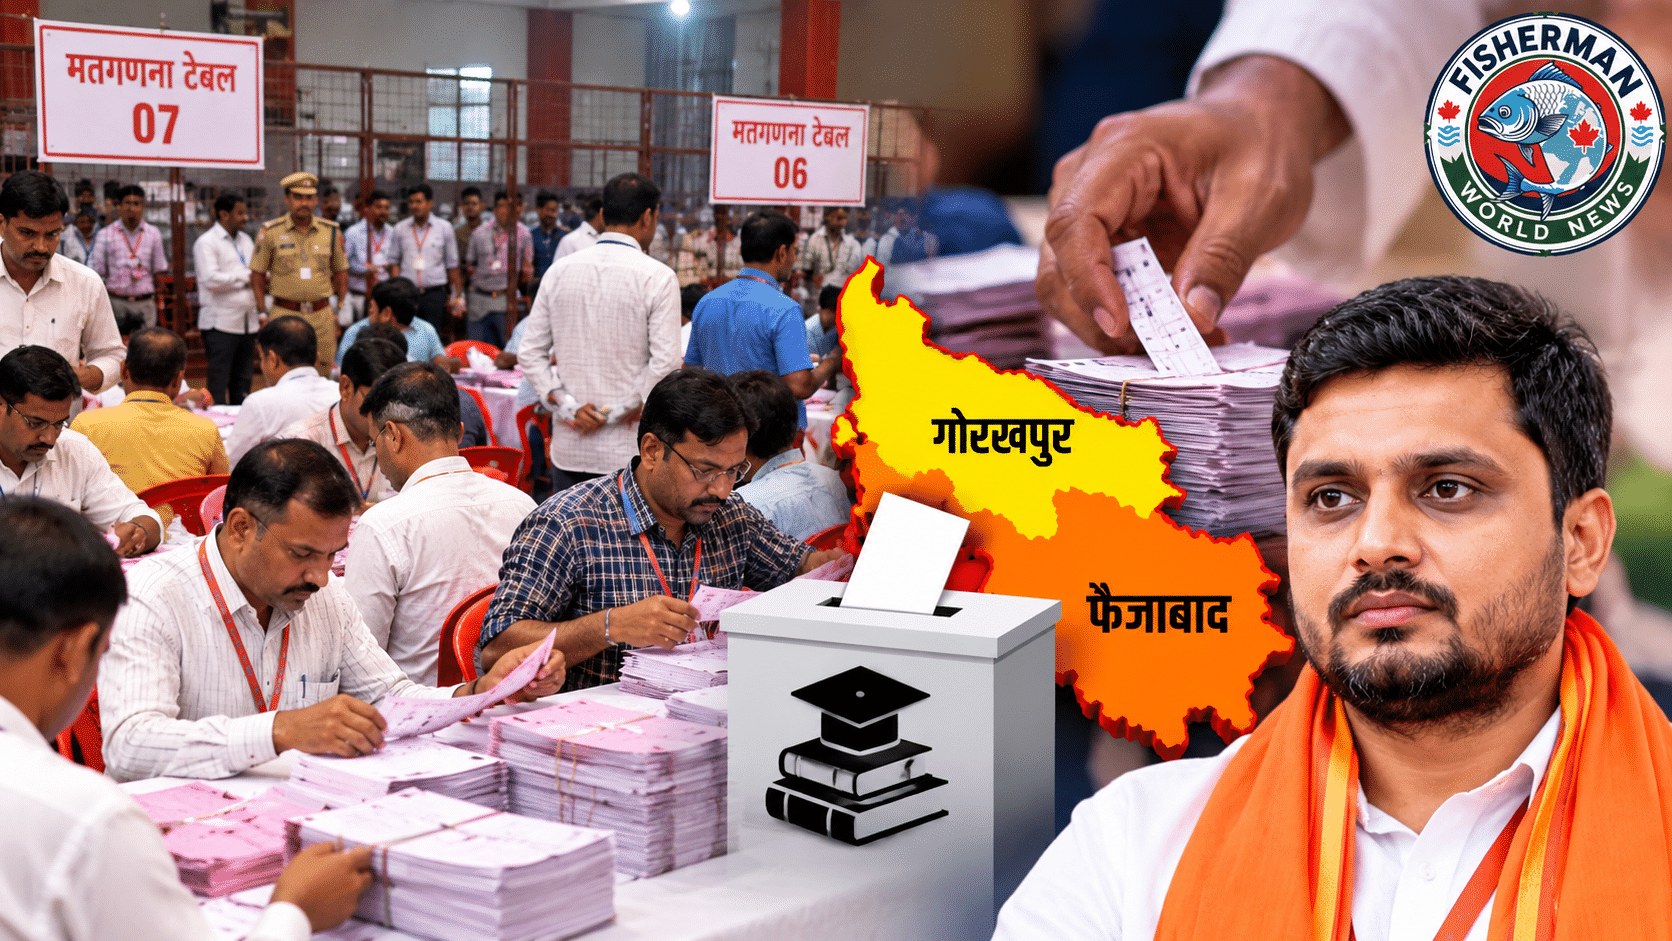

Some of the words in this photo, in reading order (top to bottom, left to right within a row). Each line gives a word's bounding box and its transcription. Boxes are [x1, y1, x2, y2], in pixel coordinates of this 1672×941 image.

[65, 53, 174, 89] मतगणना
[182, 50, 237, 92] टेबल
[133, 102, 179, 144] 07
[732, 120, 806, 146] मतगणना
[812, 116, 851, 148] टेबल
[774, 156, 807, 189] 06
